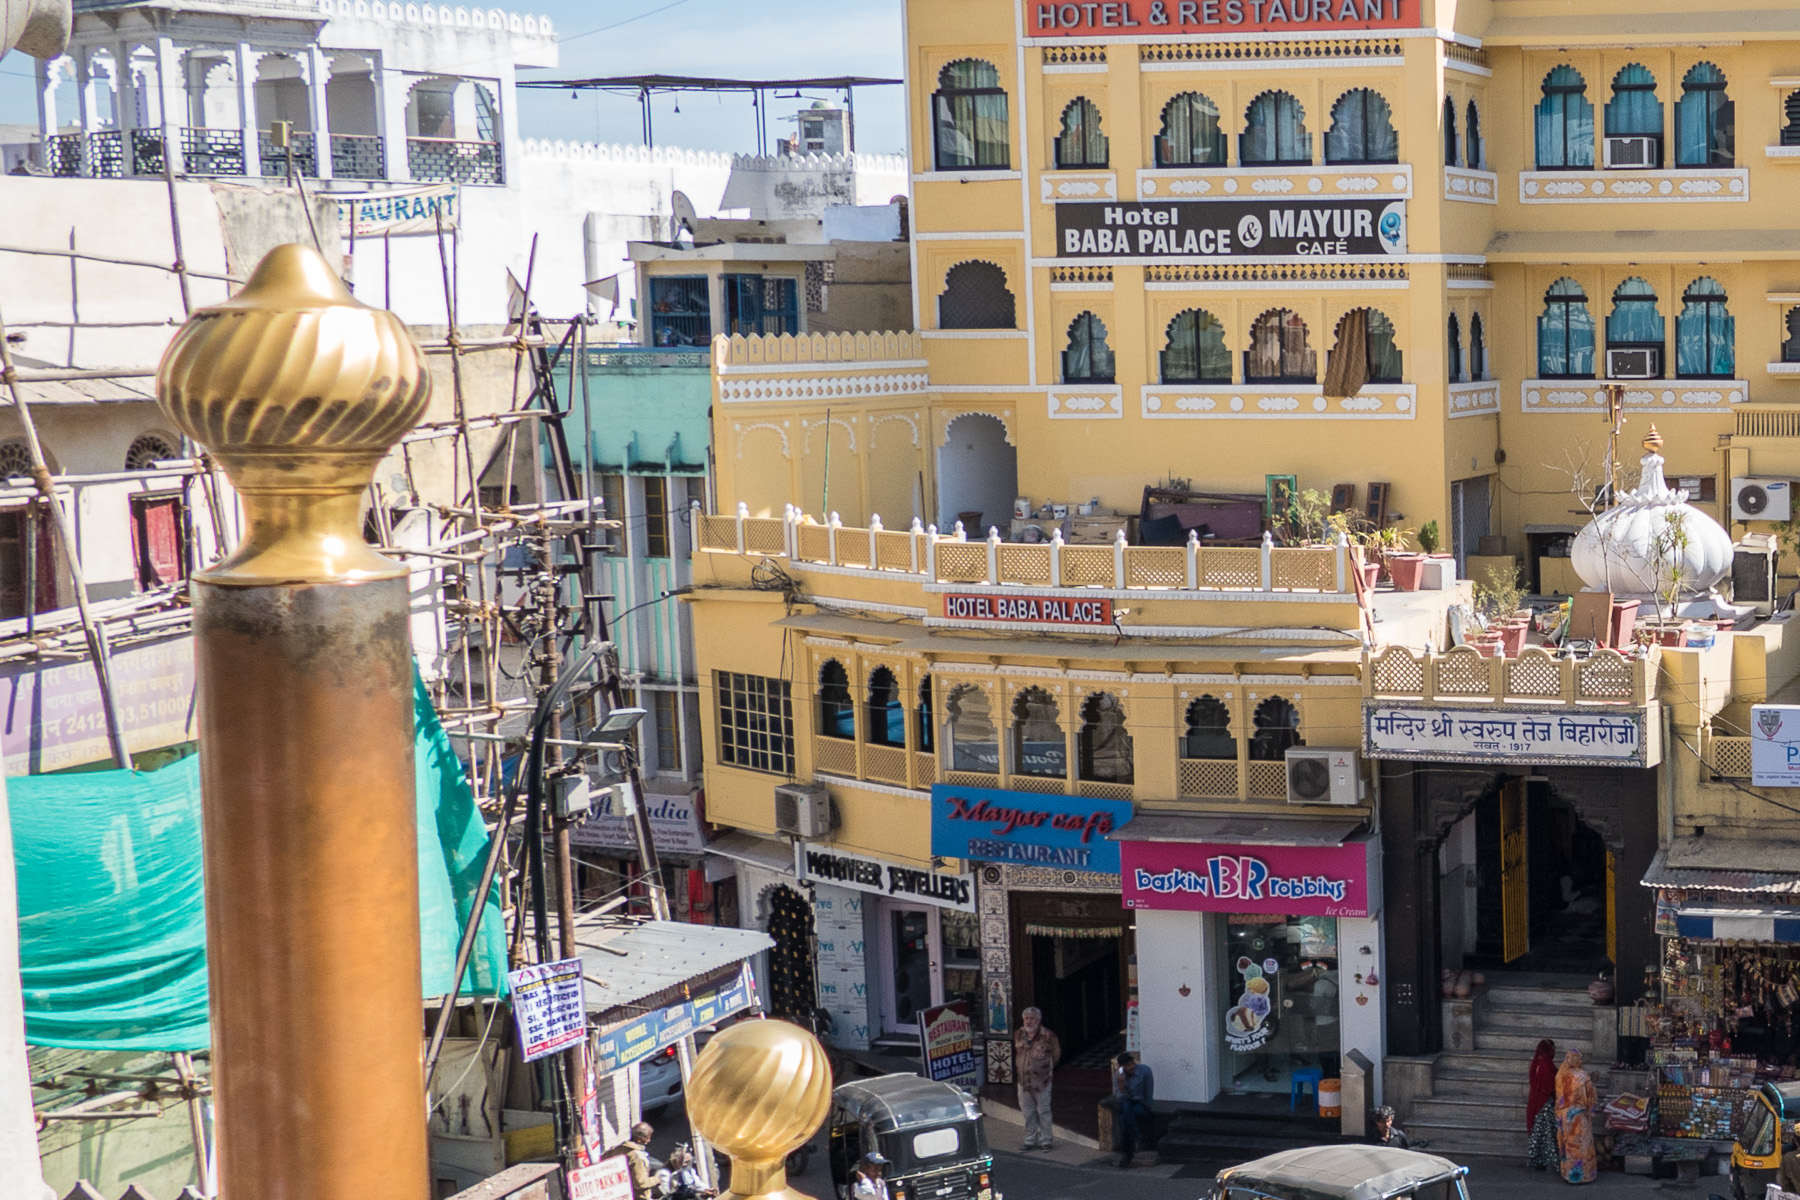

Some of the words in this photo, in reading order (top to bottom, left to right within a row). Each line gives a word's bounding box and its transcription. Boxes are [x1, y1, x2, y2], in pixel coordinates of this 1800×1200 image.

[1037, 2, 1139, 28] HOTEL
[1148, 2, 1170, 26] &
[1178, 0, 1401, 25] RESTAURANT
[1104, 207, 1179, 226] Hotel
[1065, 229, 1130, 253] BABA
[1139, 229, 1231, 254] PALACE
[1242, 221, 1259, 242] &
[1269, 210, 1373, 239] MAYUR
[1296, 237, 1348, 255] CAFÉ
[947, 597, 995, 619] HOTEL
[998, 599, 1040, 620] BABA
[1043, 600, 1103, 622] PALACE
[1374, 711, 1427, 741] मन्दिर
[1431, 712, 1454, 738] श्री
[1522, 716, 1552, 743] तेज
[1558, 717, 1635, 746] बिहारीजी
[1509, 742, 1531, 752] 1917
[646, 800, 690, 820] ndia
[946, 797, 1048, 836] Mayur
[1051, 811, 1113, 844] café
[968, 838, 1092, 866] RESTAURANT
[806, 850, 883, 889] MAHAVEER
[887, 865, 970, 904] JEWELLERS
[1135, 868, 1209, 897] baskin
[1207, 856, 1268, 900] BR
[1269, 876, 1347, 902] robbins
[1325, 906, 1337, 916] Ice
[1339, 906, 1367, 917] Cream
[928, 1018, 972, 1041] RESTAURANT
[929, 1042, 953, 1060] MAYUR
[953, 1039, 972, 1051] CAFE
[932, 1051, 974, 1071] HOTEL
[934, 1067, 950, 1081] BABA
[951, 1061, 976, 1077] PALACE
